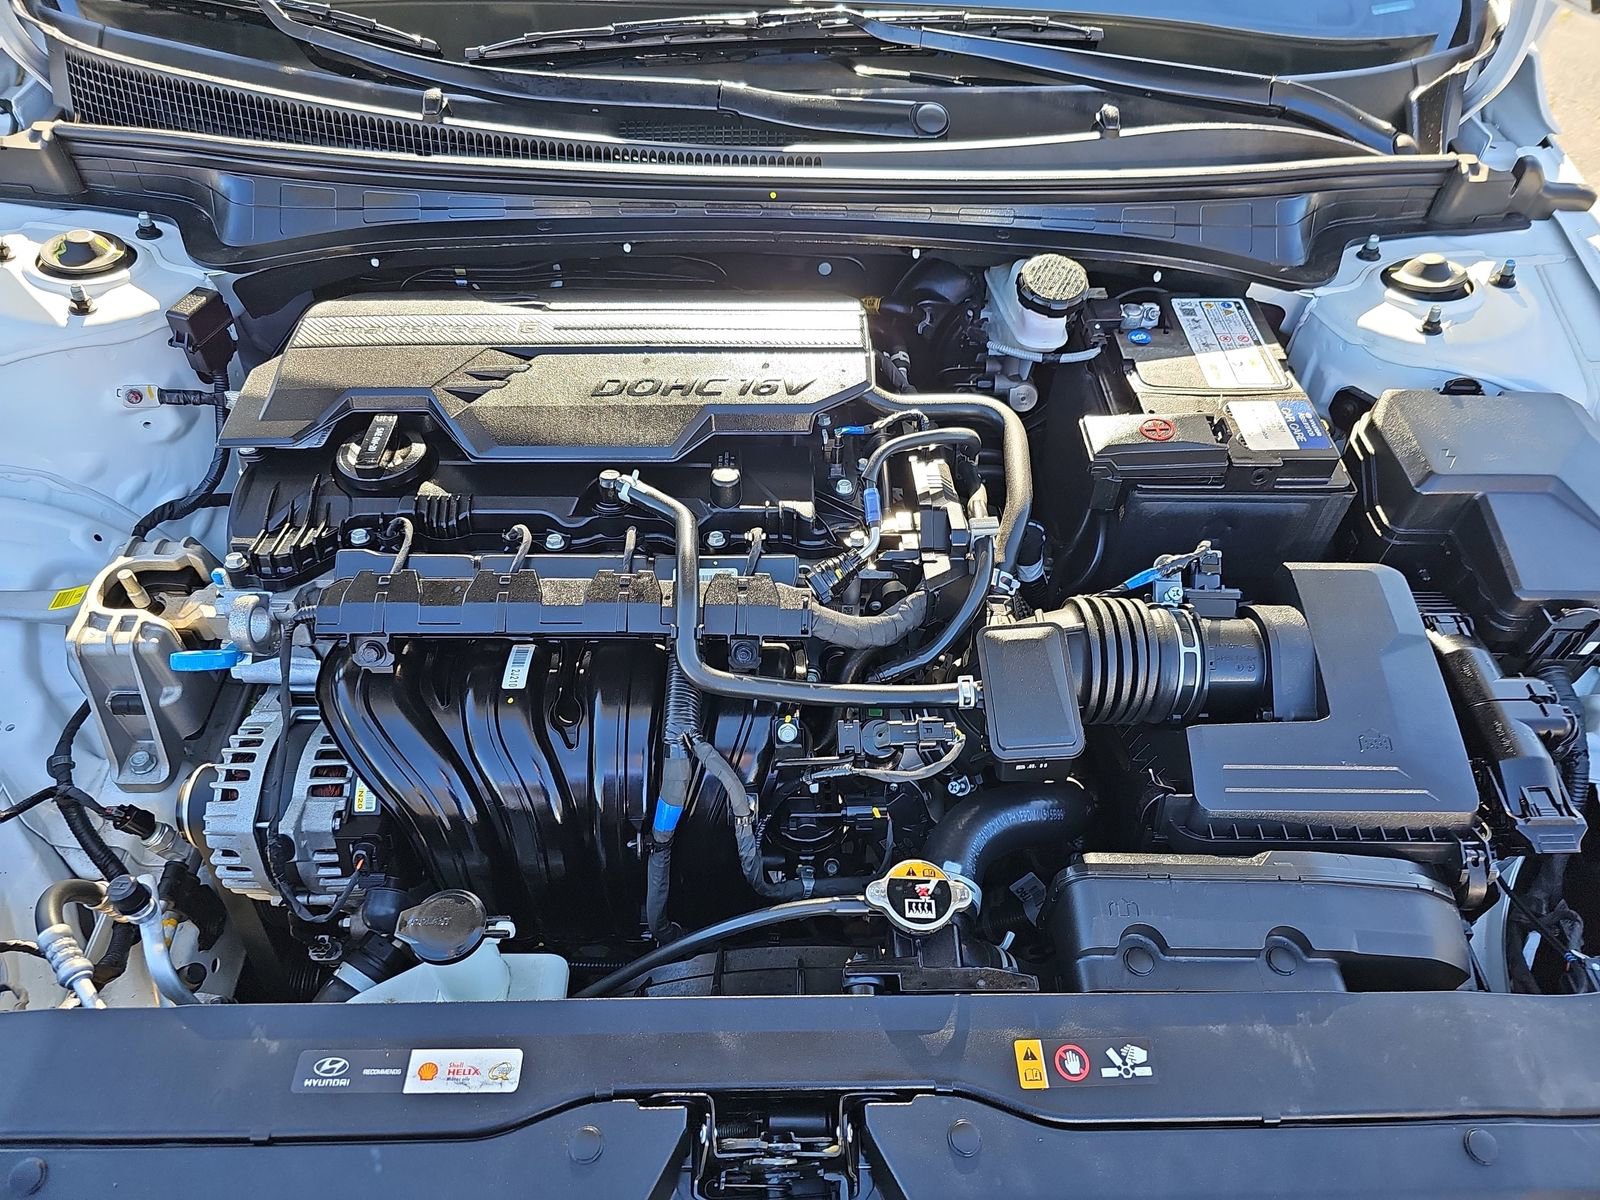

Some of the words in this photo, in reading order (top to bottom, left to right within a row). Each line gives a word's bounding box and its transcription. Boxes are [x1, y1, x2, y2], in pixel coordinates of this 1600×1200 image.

[591, 378, 729, 397] DOHC
[738, 378, 817, 397] 16V
[304, 1078, 351, 1087] HYUNDAI
[362, 1068, 402, 1076] RECOMMENDS
